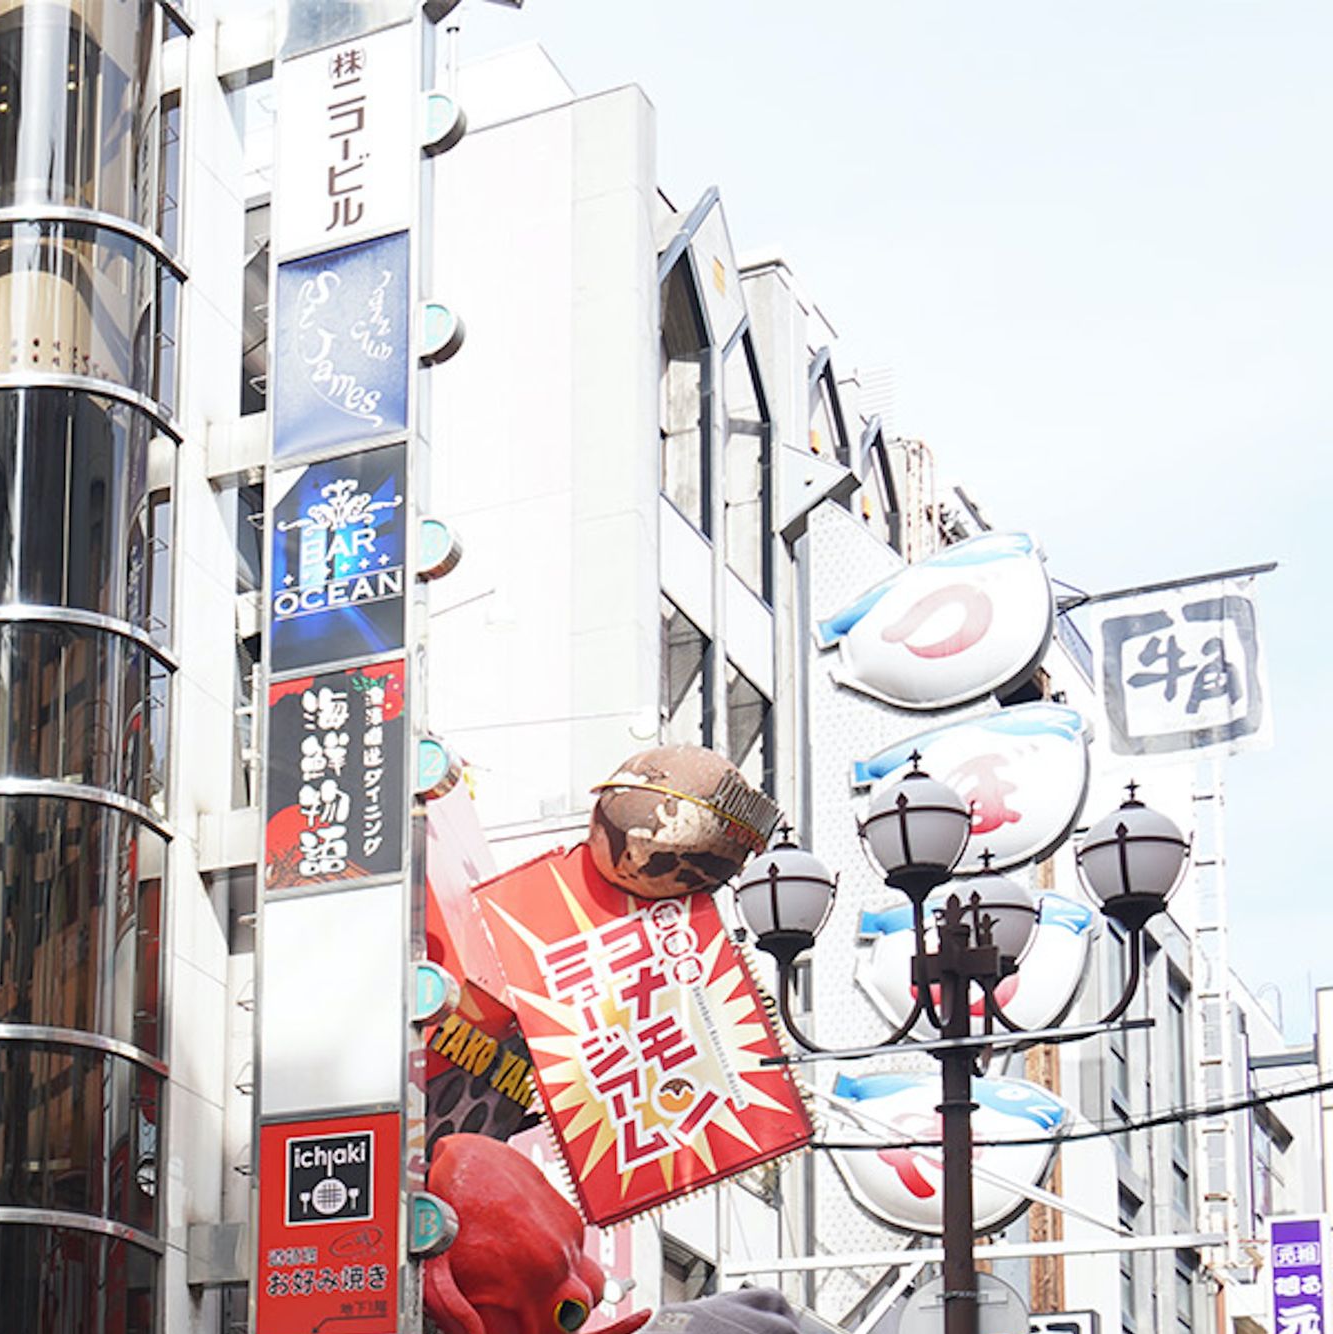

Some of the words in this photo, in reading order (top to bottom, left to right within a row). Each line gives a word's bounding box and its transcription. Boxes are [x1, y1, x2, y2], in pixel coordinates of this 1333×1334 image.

[302, 528, 376, 567] BAR
[274, 570, 405, 619] OCEAN
[432, 1012, 499, 1077] TAKO
[266, 1264, 389, 1297] お好み焼き
